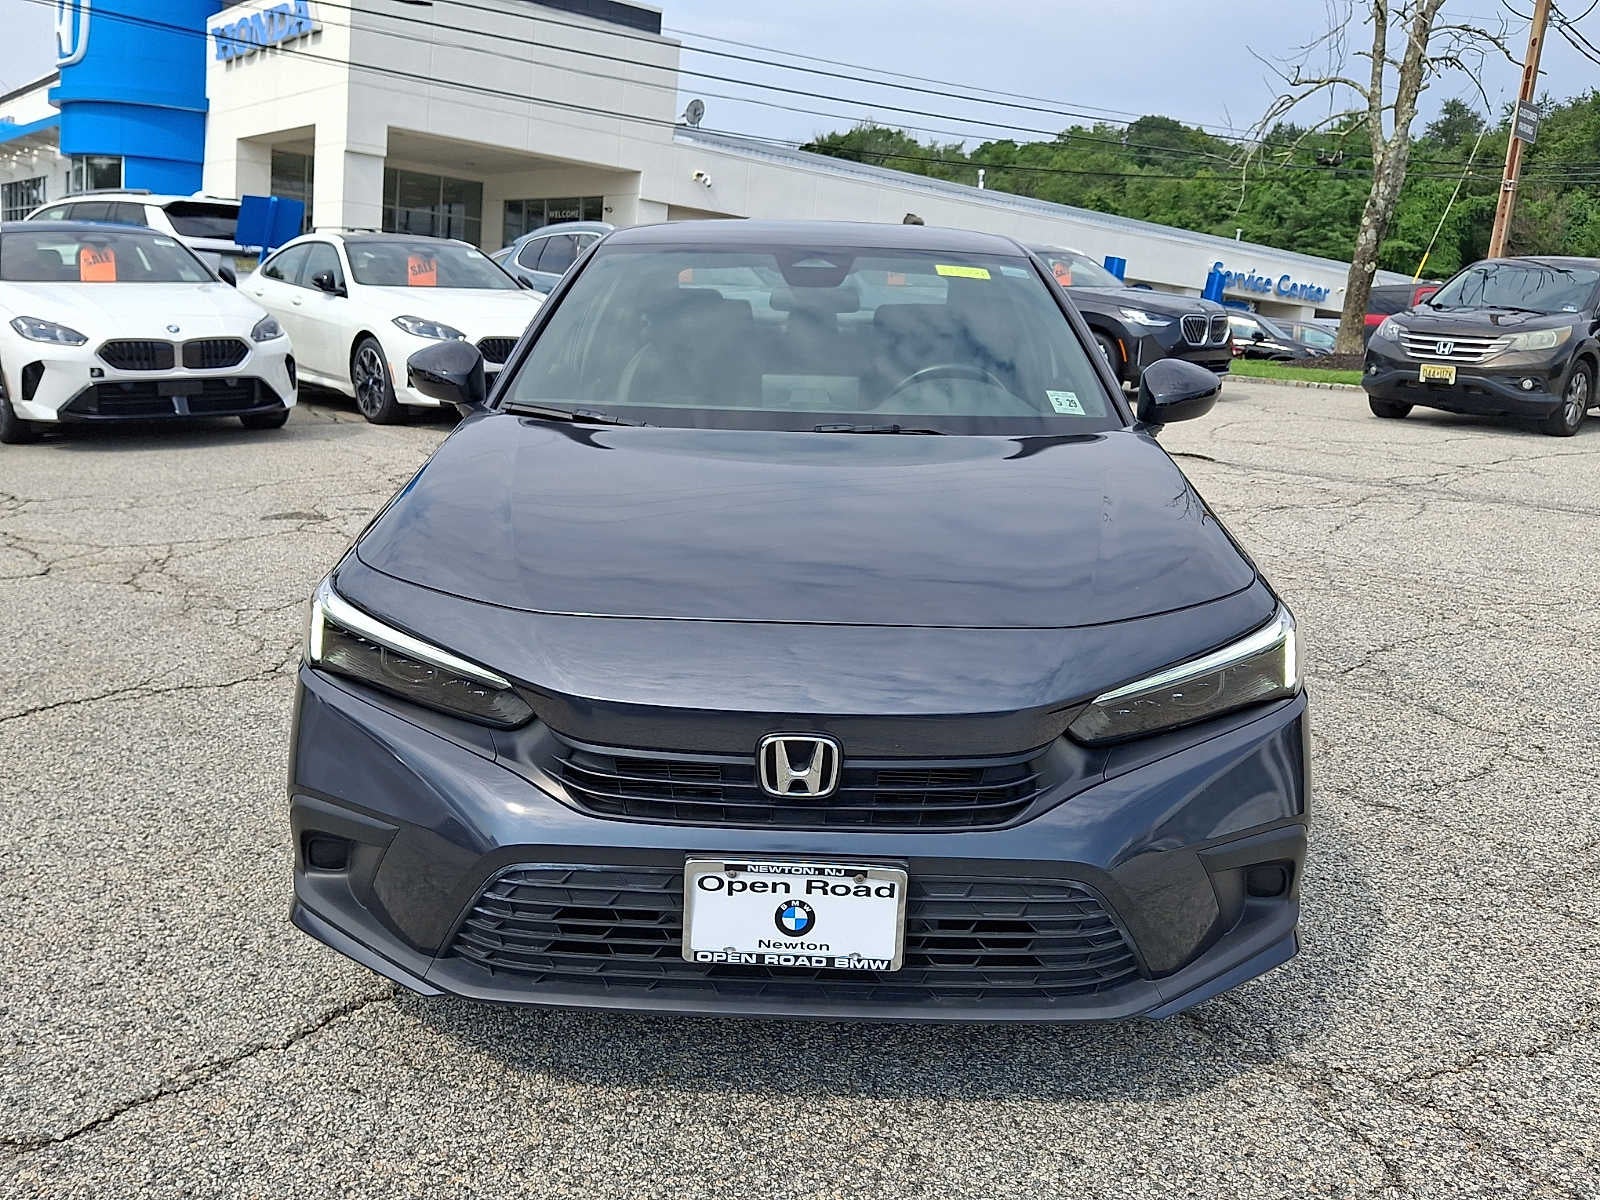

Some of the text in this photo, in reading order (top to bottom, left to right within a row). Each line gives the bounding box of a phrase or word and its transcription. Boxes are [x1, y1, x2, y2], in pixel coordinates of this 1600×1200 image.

[211, 0, 312, 60] HONDA
[549, 209, 580, 219] WELCOME
[1277, 274, 1331, 302] Center
[1065, 398, 1078, 408] 29
[824, 867, 845, 877] NJ
[697, 874, 896, 899] Open Road
[780, 900, 812, 912] BMW
[758, 939, 830, 951] Newton
[696, 951, 889, 970] OPEN ROAD BMW
